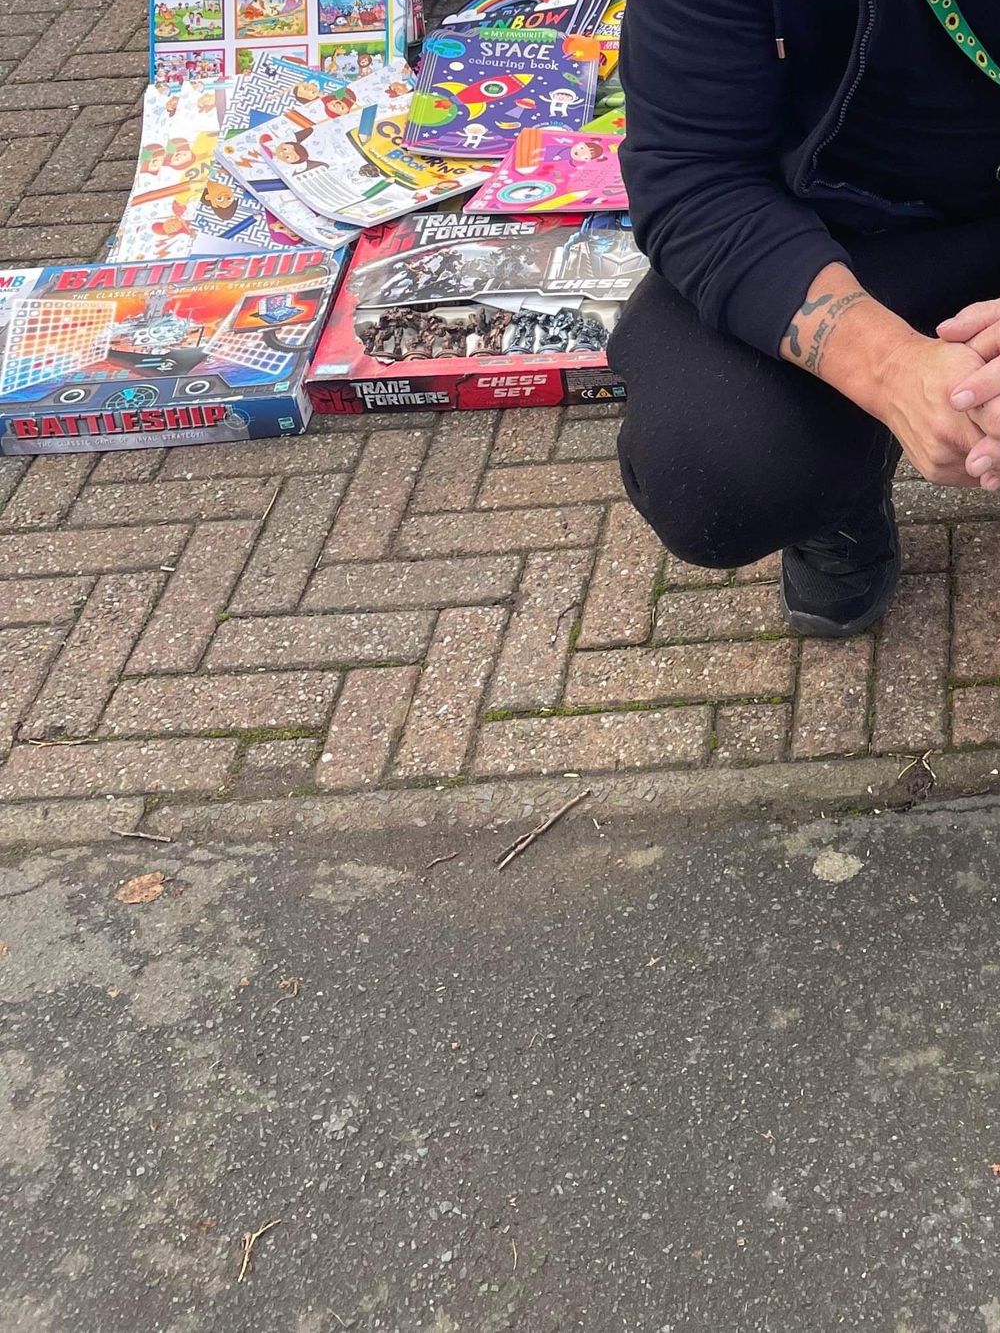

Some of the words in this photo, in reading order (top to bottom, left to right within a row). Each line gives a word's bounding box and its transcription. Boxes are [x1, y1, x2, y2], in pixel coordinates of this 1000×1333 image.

[506, 31, 546, 39] FAVOURITE
[480, 42, 554, 61] SPACE
[468, 56, 525, 71] colouring
[530, 60, 559, 72] book
[413, 214, 493, 232] TRANS
[420, 222, 537, 244] FORMERS
[54, 252, 326, 292] BATTLESHIP
[96, 291, 137, 299] CLASSIC
[144, 289, 167, 297] GAME
[173, 287, 185, 295] OF
[192, 284, 220, 293] NAVAL
[227, 280, 280, 290] STRATEGY!
[549, 278, 632, 291] CHESS
[352, 380, 411, 395] TRANS
[477, 374, 548, 387] CHESS
[365, 392, 450, 409] FORMERS
[494, 386, 536, 398] SET
[13, 404, 227, 439] BATTLESHIP
[37, 440, 51, 448] THE
[56, 438, 91, 447] CLASSIC
[94, 437, 113, 445] GAME
[118, 435, 128, 443] OF
[133, 434, 157, 443] NAVAL
[162, 431, 207, 441] STRATEGY!
